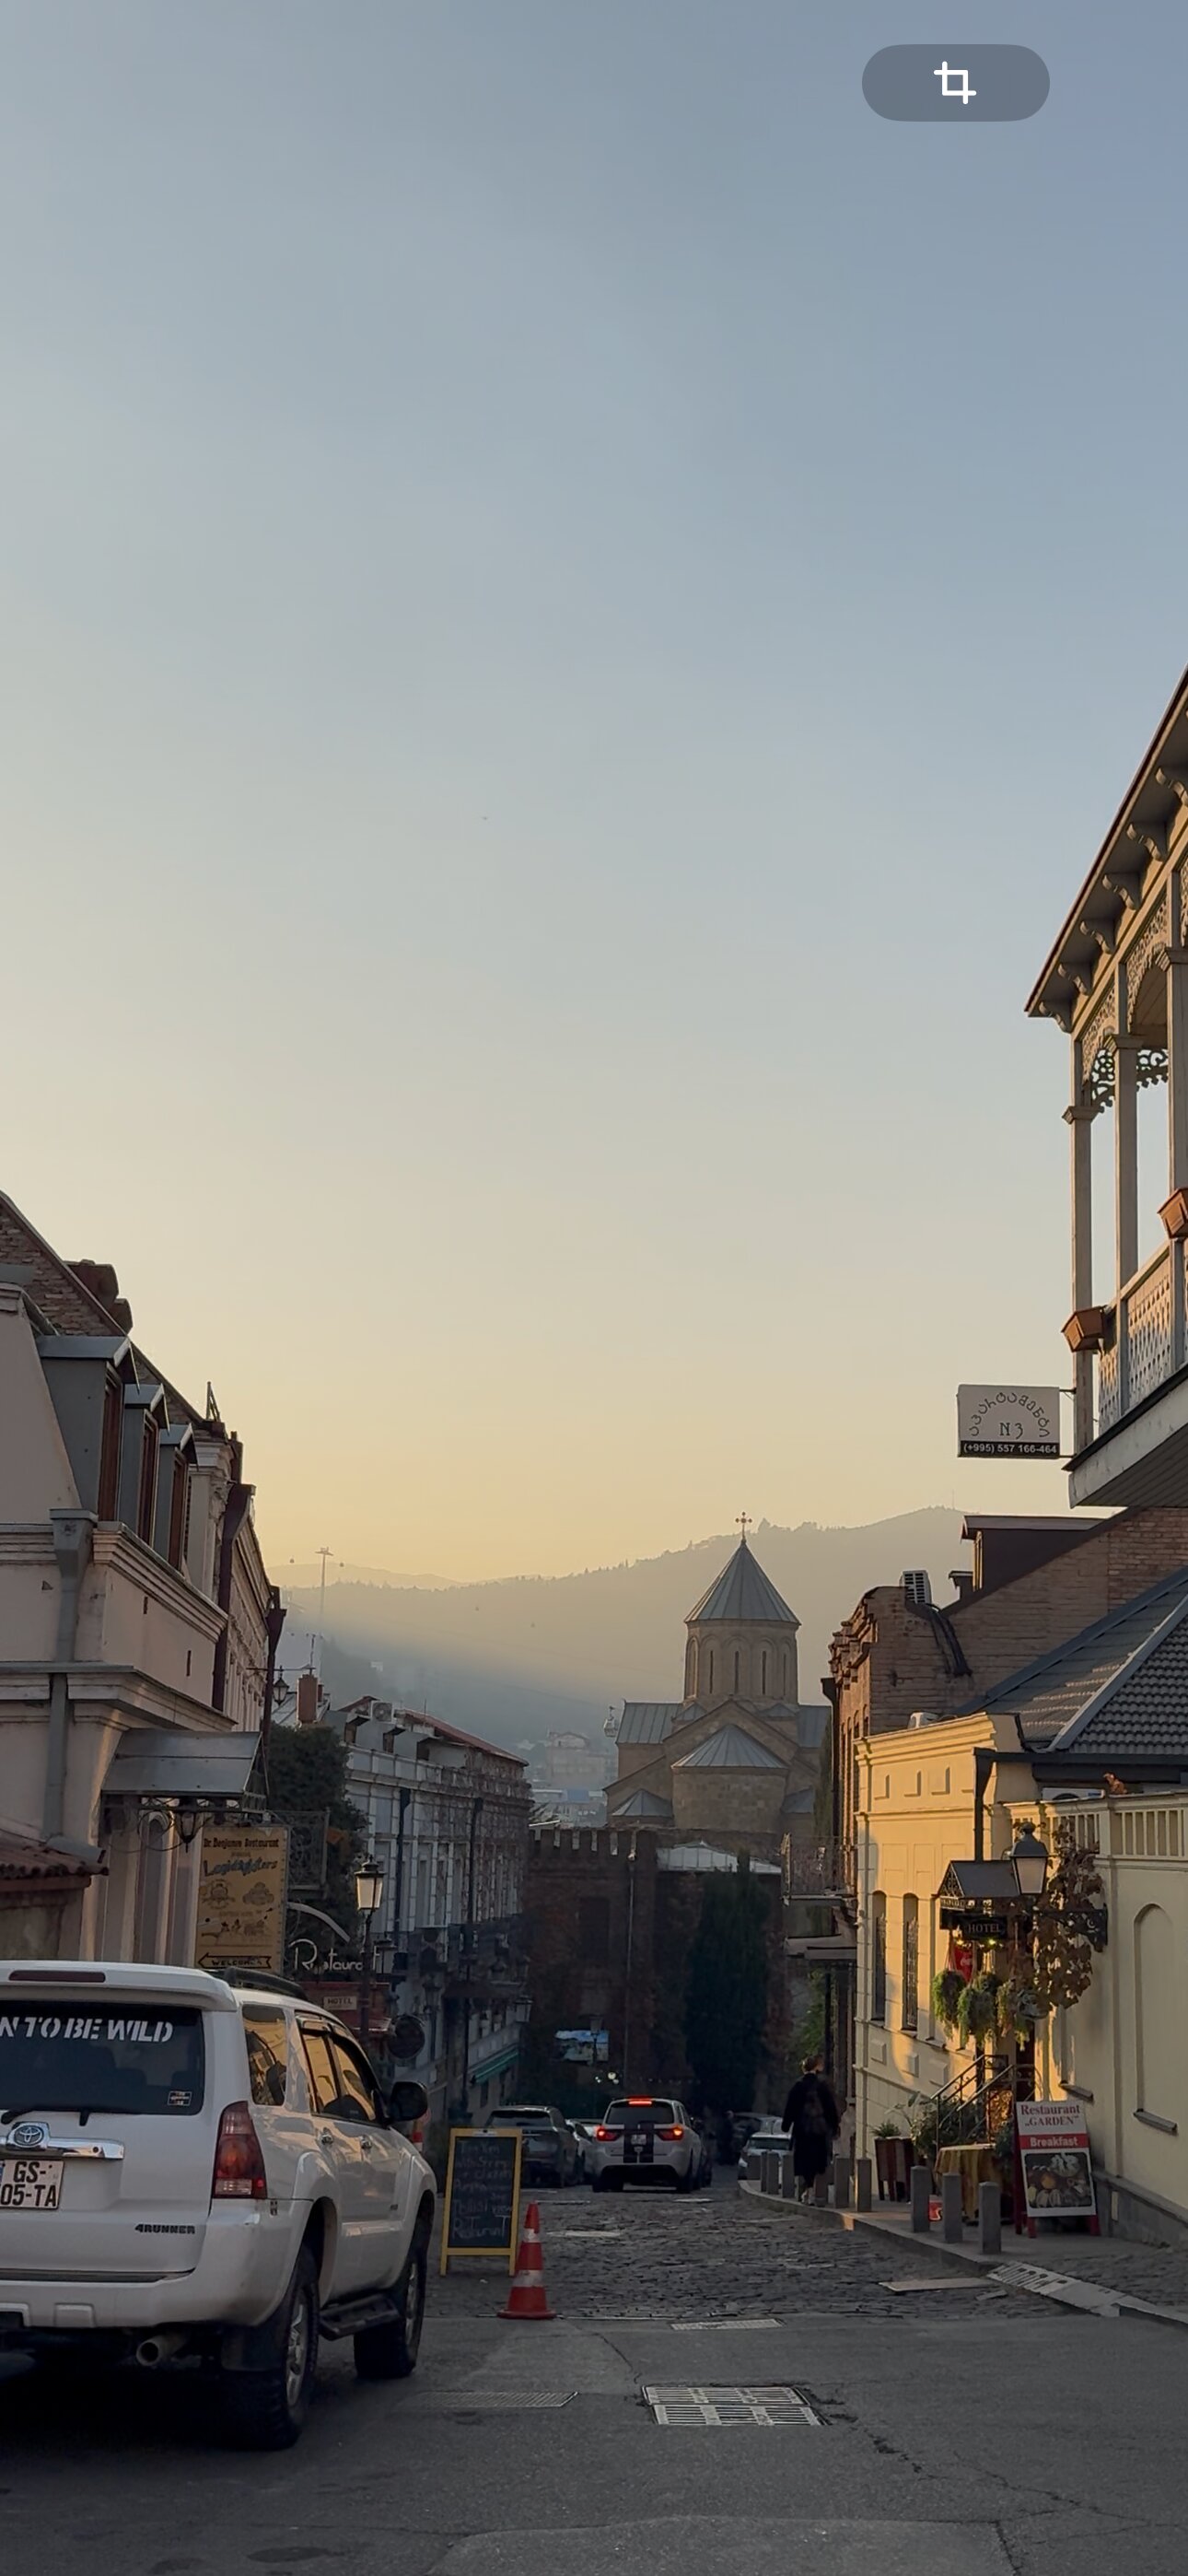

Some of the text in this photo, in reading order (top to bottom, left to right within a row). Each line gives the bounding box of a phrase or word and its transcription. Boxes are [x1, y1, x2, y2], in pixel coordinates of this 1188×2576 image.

[963, 1443, 1056, 1454] (+995) 557 166-464
[968, 1923, 1001, 1934] HOTEL
[25, 2017, 61, 2038] TO
[64, 2018, 103, 2040] BE
[107, 2020, 173, 2043] WILD
[1020, 2104, 1080, 2115] Restaurant
[1030, 2136, 1078, 2148] Breakfast
[0, 2184, 56, 2207] 05-TA
[134, 2223, 195, 2234] 4RUNNER
